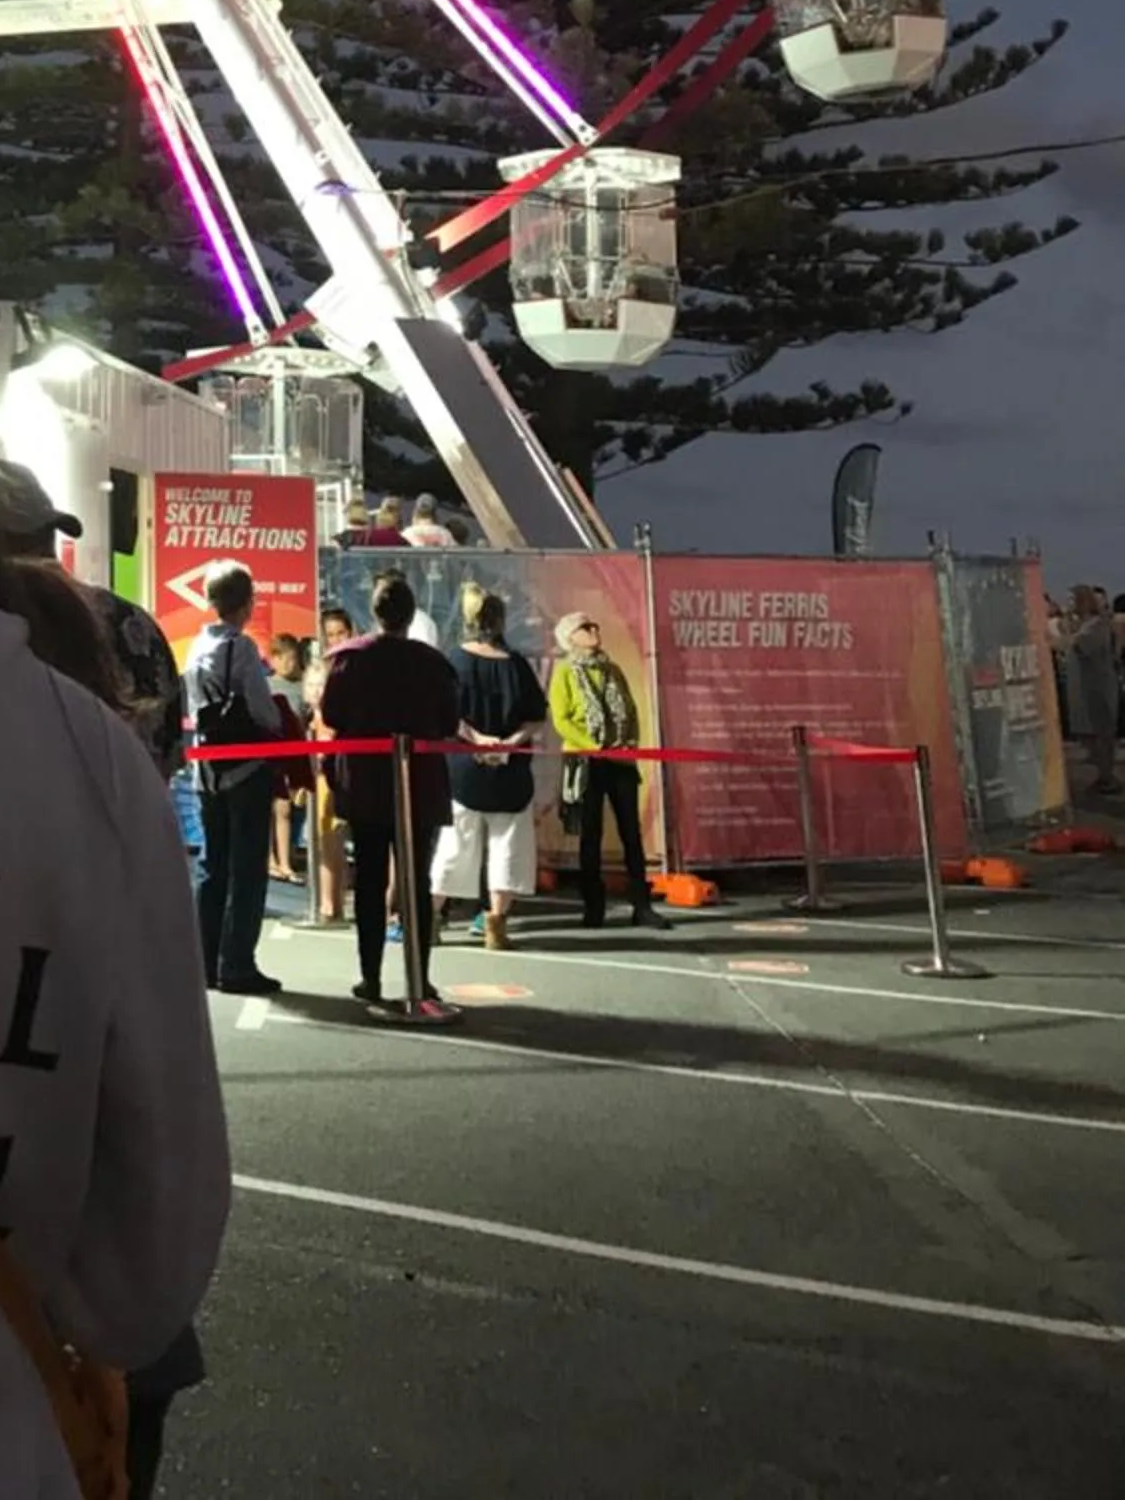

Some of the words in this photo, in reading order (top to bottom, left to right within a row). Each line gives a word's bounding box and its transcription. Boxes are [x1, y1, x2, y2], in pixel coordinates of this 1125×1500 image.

[165, 487, 232, 502] WELCOME
[236, 490, 253, 503] TO
[165, 503, 253, 526] SKYLINE
[164, 526, 308, 551] ATTRACTIONS
[668, 589, 753, 618] SKYLINE
[759, 592, 829, 619] FERRIS
[672, 619, 742, 648] WHEEL
[748, 620, 787, 648] FUN
[793, 621, 855, 650] FACTS
